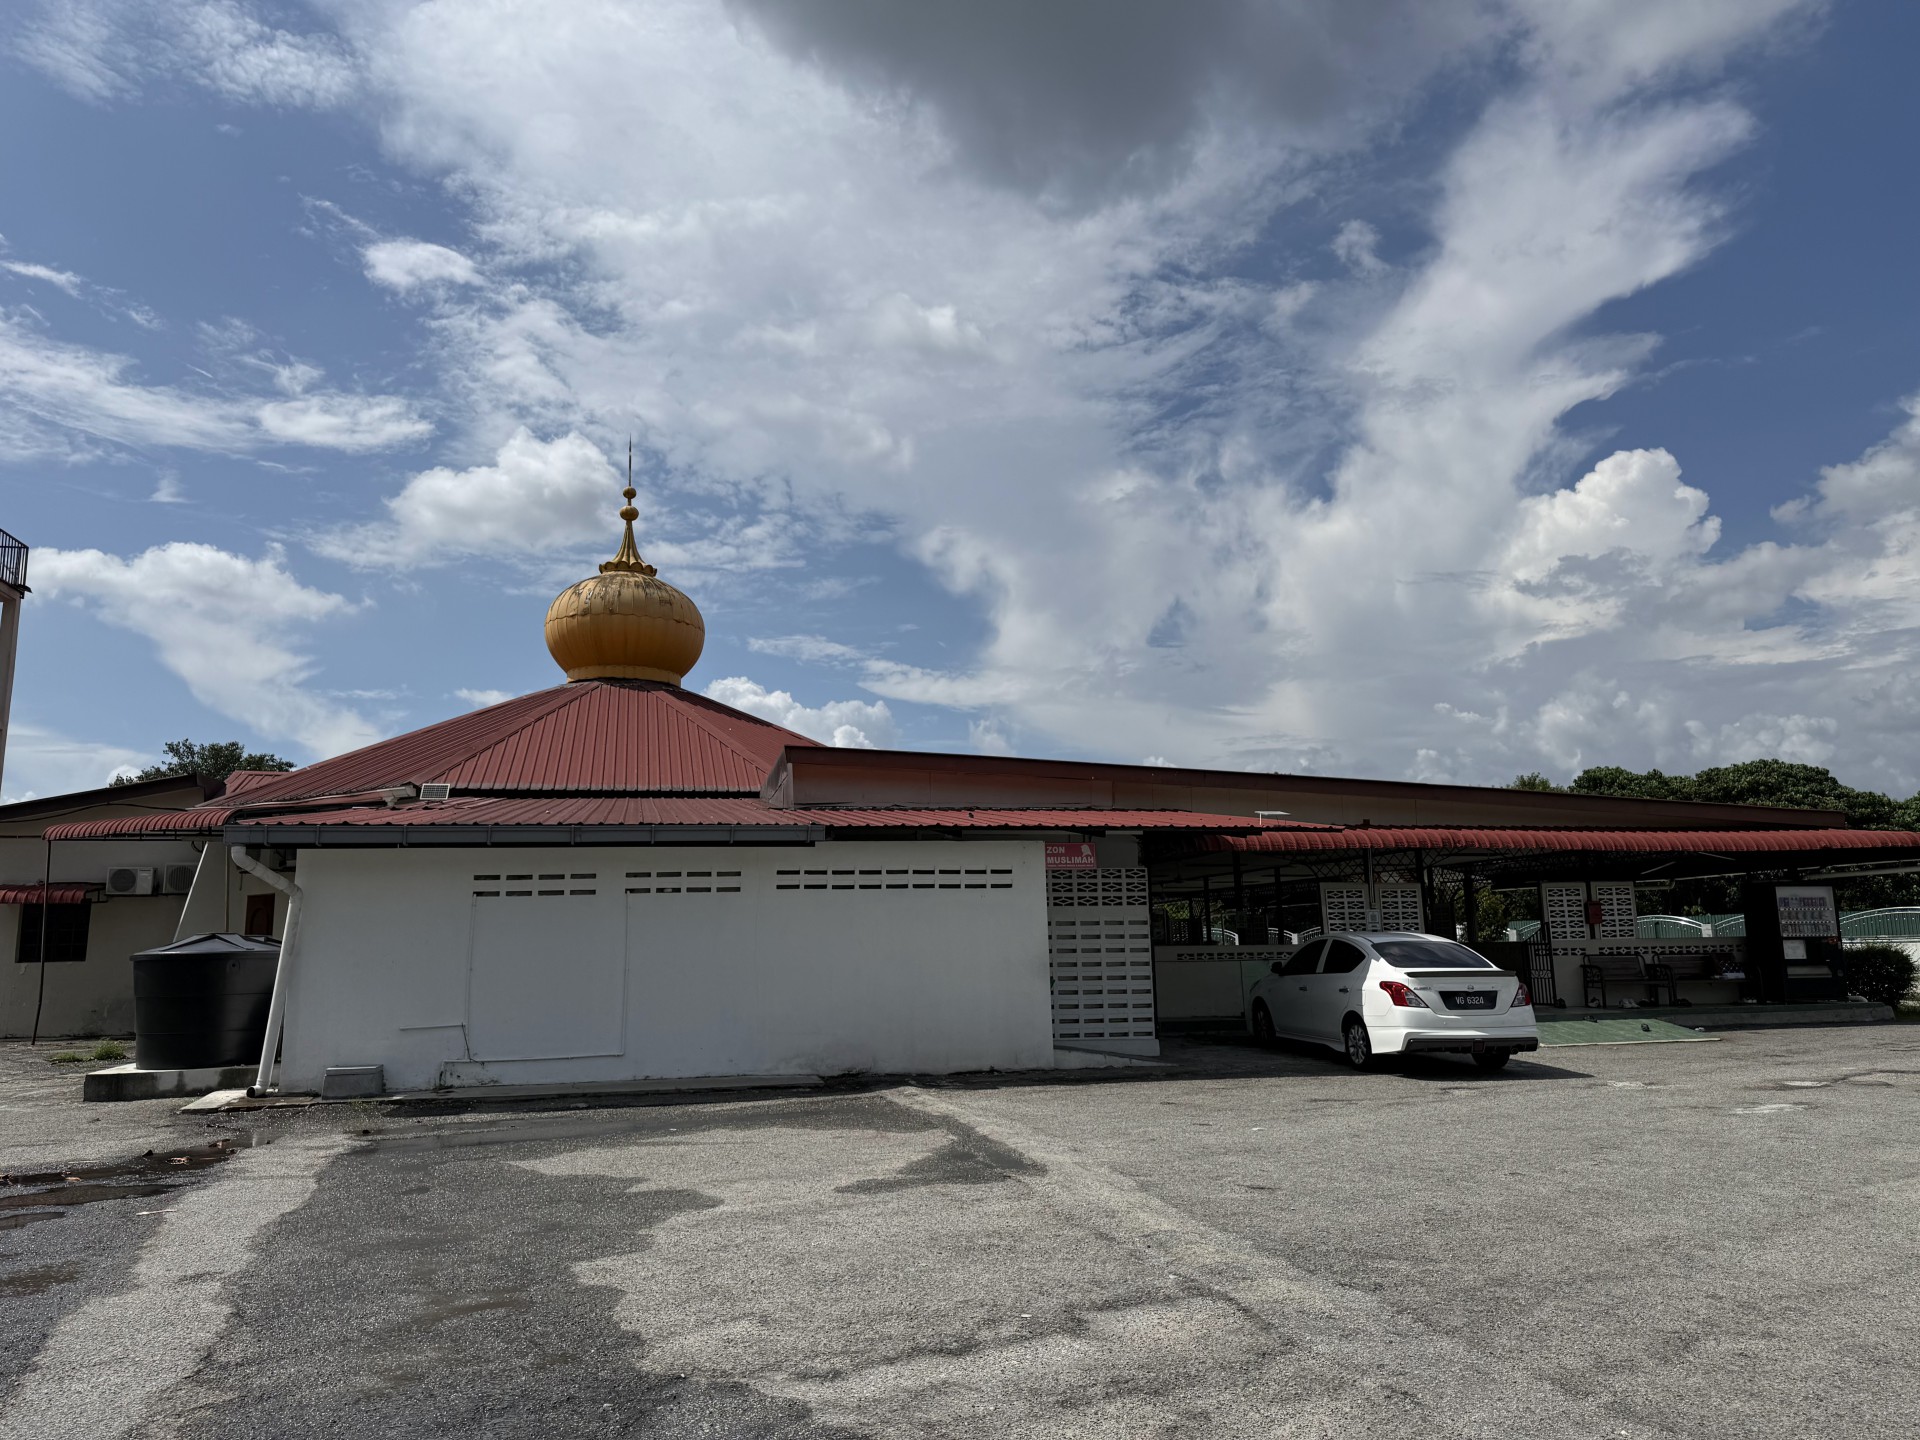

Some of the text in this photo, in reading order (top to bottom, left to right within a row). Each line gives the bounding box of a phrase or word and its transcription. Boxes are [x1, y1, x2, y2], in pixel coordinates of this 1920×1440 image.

[1046, 846, 1065, 854] ZON
[1047, 856, 1094, 864] MUSLIMAH
[1455, 996, 1465, 1005] VG
